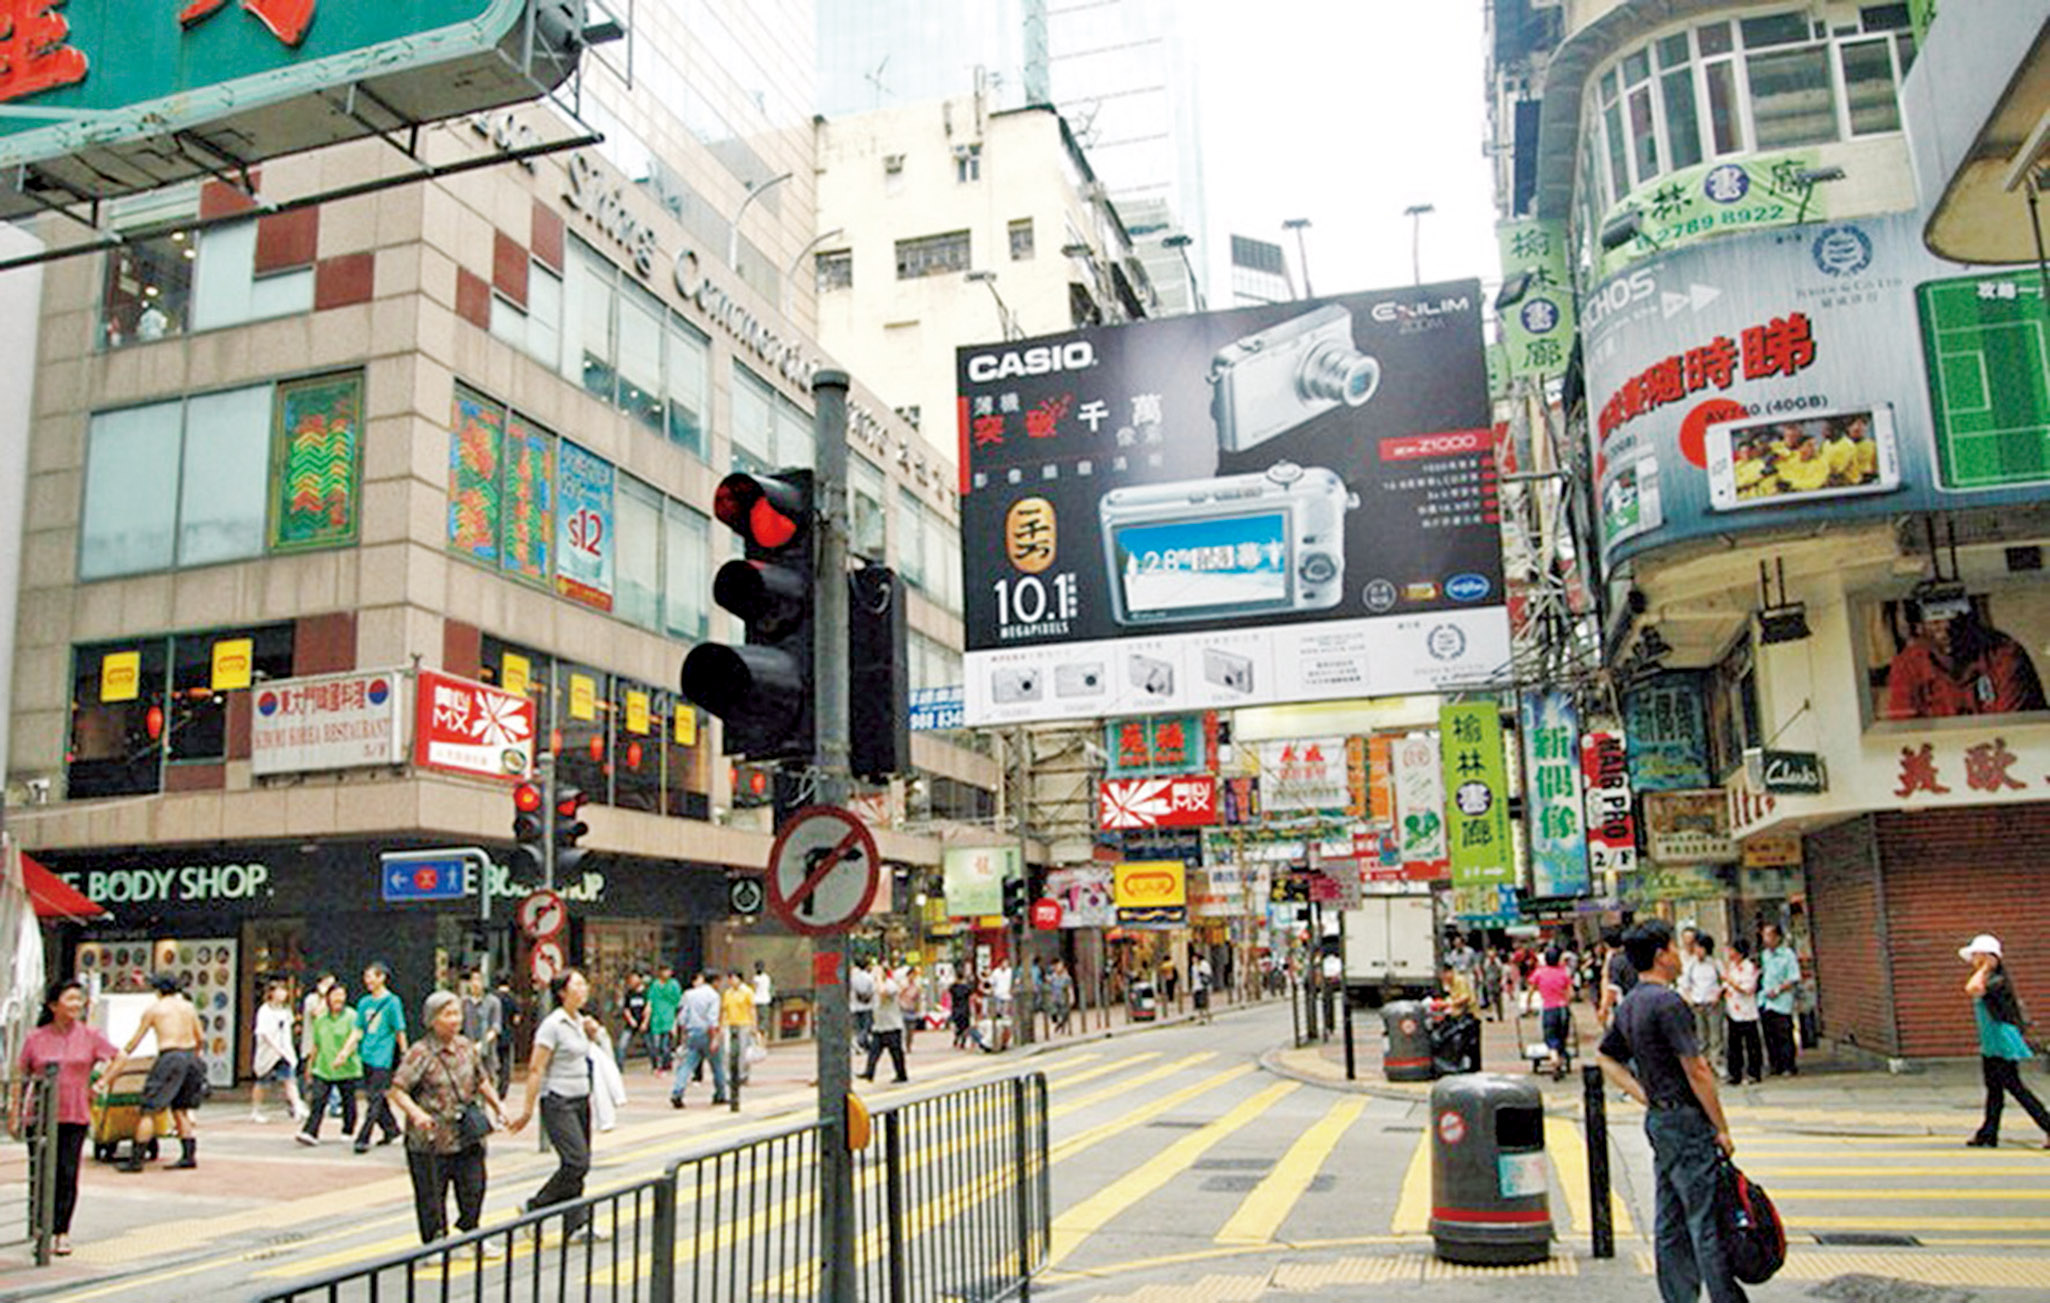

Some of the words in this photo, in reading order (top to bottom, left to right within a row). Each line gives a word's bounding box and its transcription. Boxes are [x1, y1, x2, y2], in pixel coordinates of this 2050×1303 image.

[1656, 214, 1715, 245] 2789
[1720, 204, 1785, 225] 8922
[968, 340, 1094, 383] CASIO
[993, 572, 1068, 625] 10.1
[1893, 737, 2050, 798] 美歐
[1602, 795, 1630, 839] PRO
[88, 868, 175, 902] BODY
